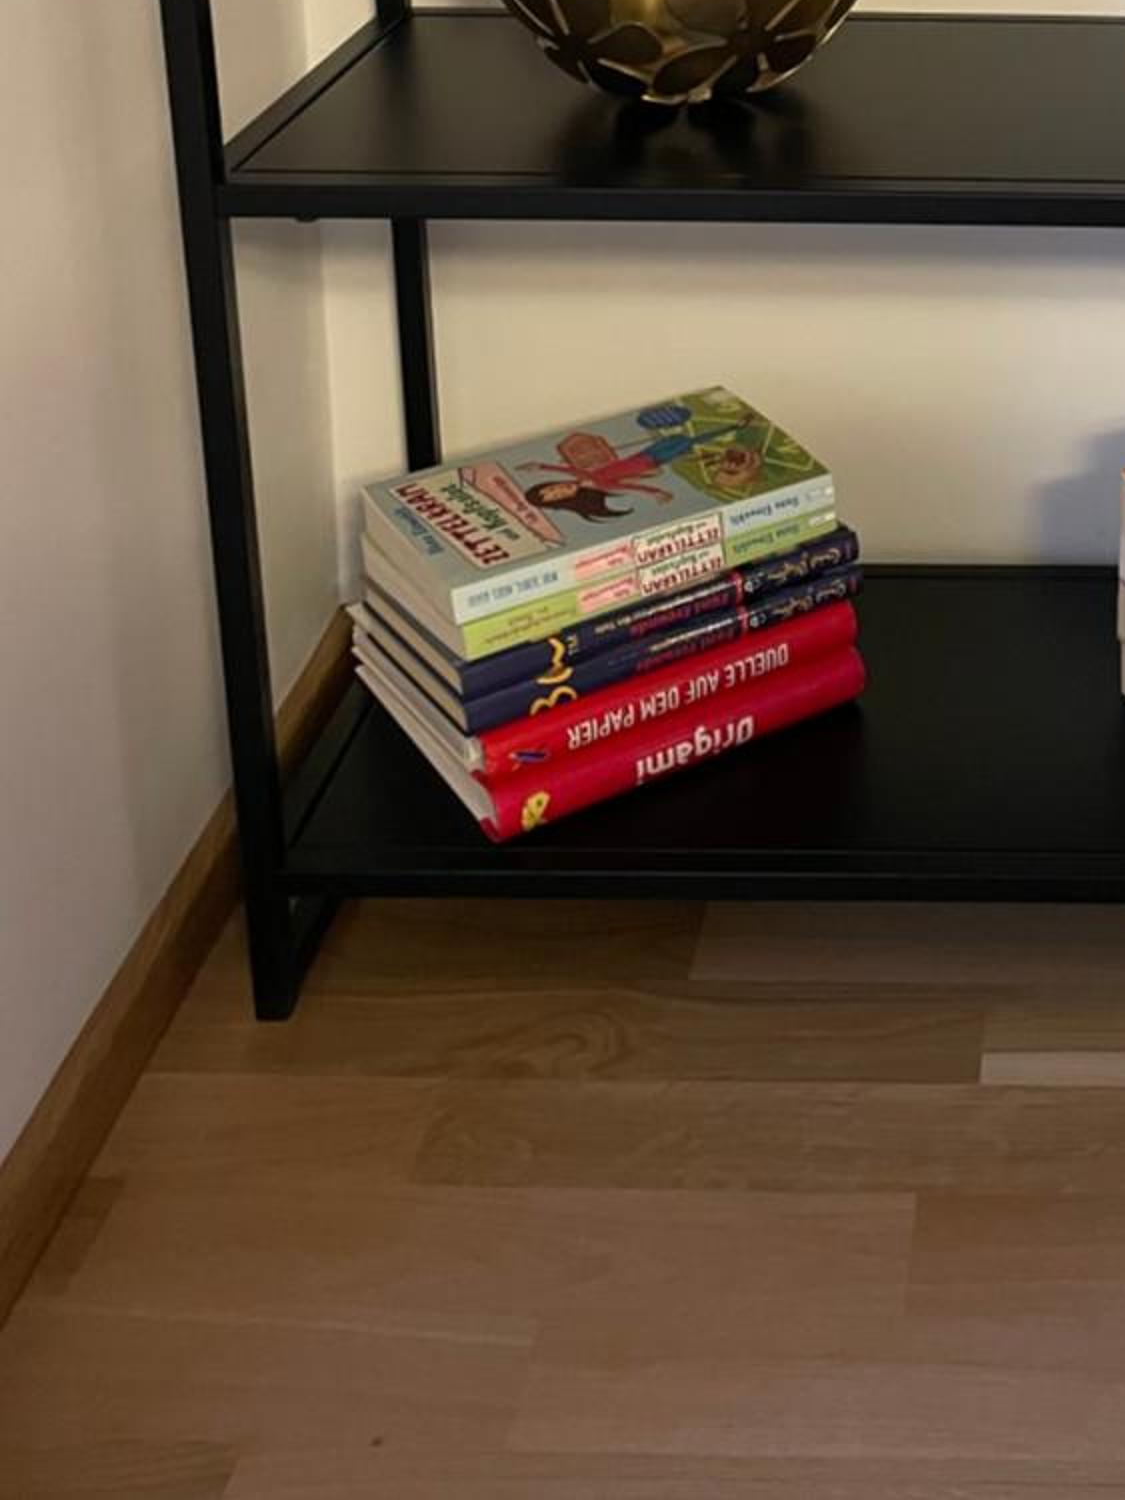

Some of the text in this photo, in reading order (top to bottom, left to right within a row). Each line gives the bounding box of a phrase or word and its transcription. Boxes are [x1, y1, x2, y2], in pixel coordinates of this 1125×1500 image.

[567, 643, 789, 749] DUELLE AUF DEM PAPIER
[636, 716, 755, 785] Origami
